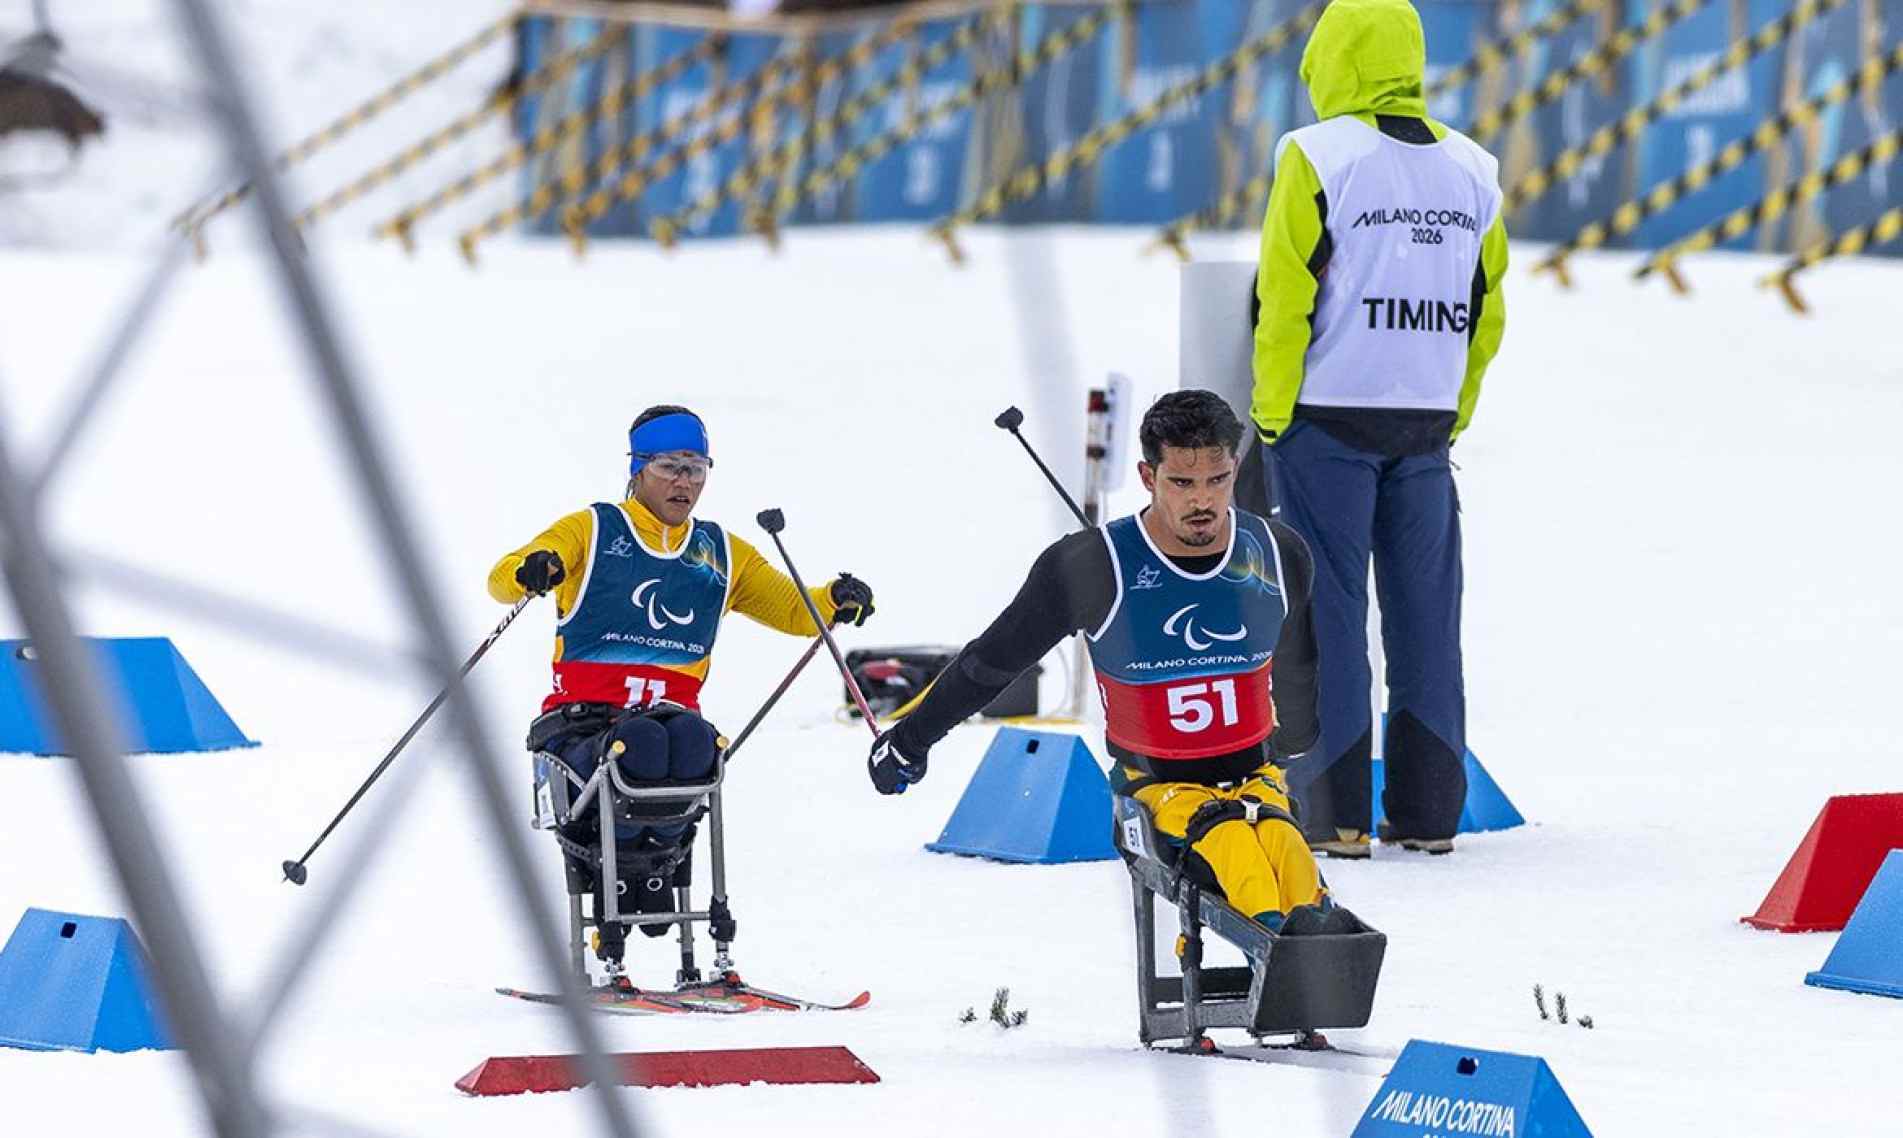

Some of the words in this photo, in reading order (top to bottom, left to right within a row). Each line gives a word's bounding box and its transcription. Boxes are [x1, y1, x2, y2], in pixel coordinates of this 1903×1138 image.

[1353, 208, 1421, 228] MILANO
[1424, 209, 1476, 231] CORTIN
[1410, 228, 1443, 244] 2026
[1363, 298, 1468, 333] TIMING
[601, 632, 645, 645] MILANO
[646, 637, 685, 651] CORTINA
[1126, 658, 1185, 671] MILANO
[1189, 655, 1248, 666] CORTINA
[624, 675, 666, 709] 11
[1167, 678, 1238, 733] 51
[1371, 1090, 1448, 1127] MILANO
[1447, 1099, 1515, 1138] CORTINA
